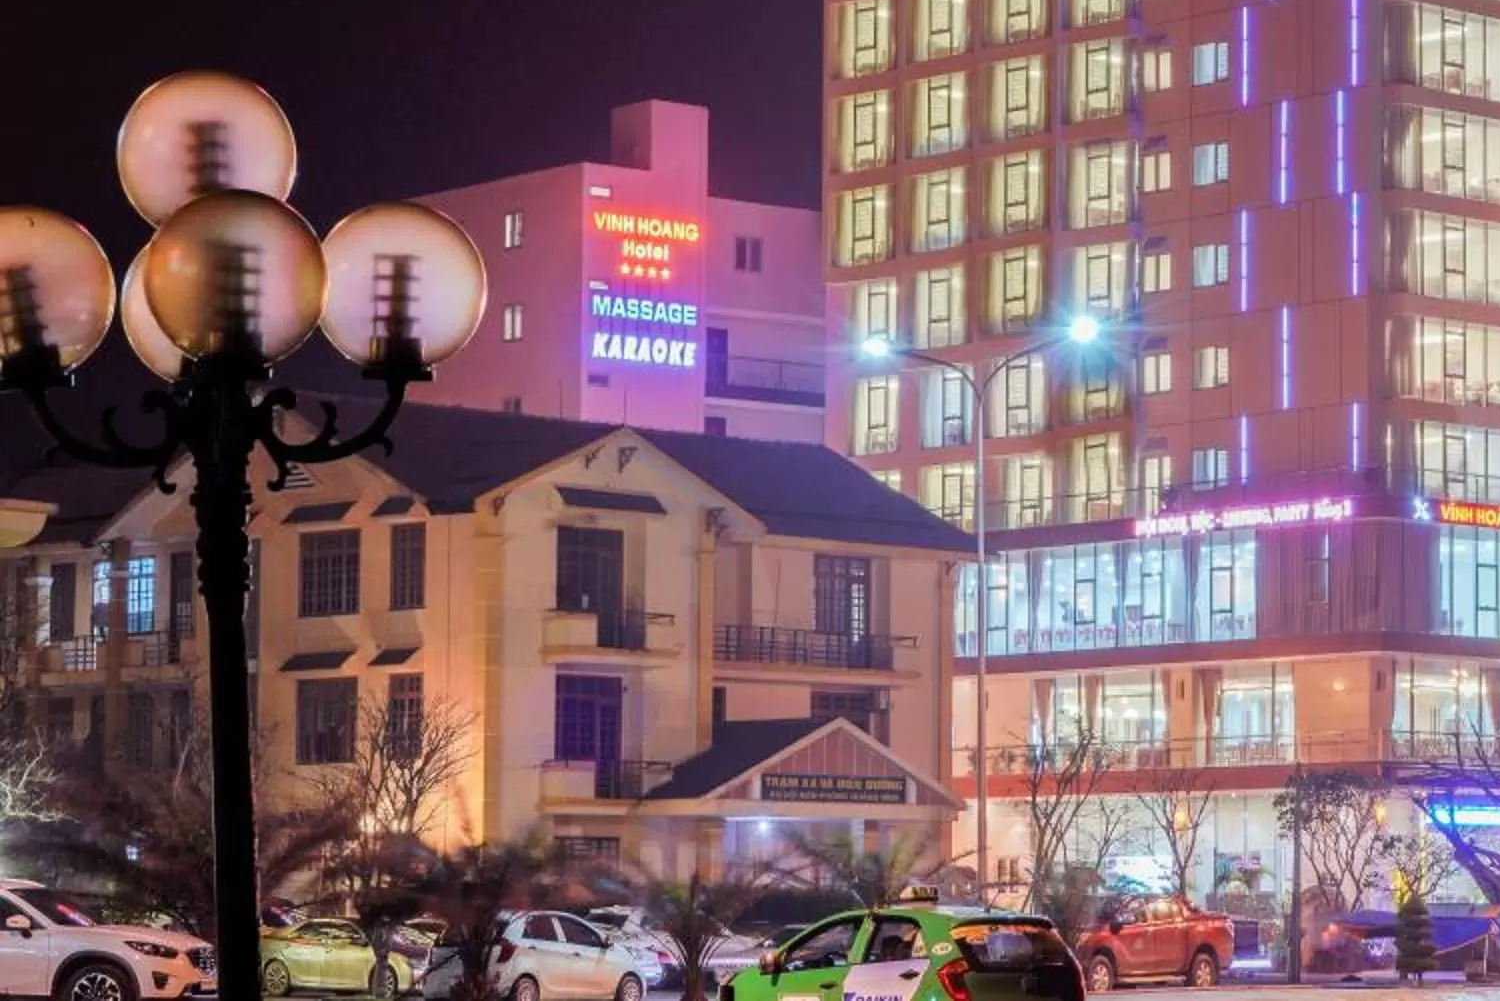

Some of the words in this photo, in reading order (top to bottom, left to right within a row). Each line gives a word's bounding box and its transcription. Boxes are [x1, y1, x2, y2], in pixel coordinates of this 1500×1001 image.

[622, 238, 669, 261] Hotel
[592, 295, 697, 325] MASSAGE
[592, 332, 697, 367] KARAOKE
